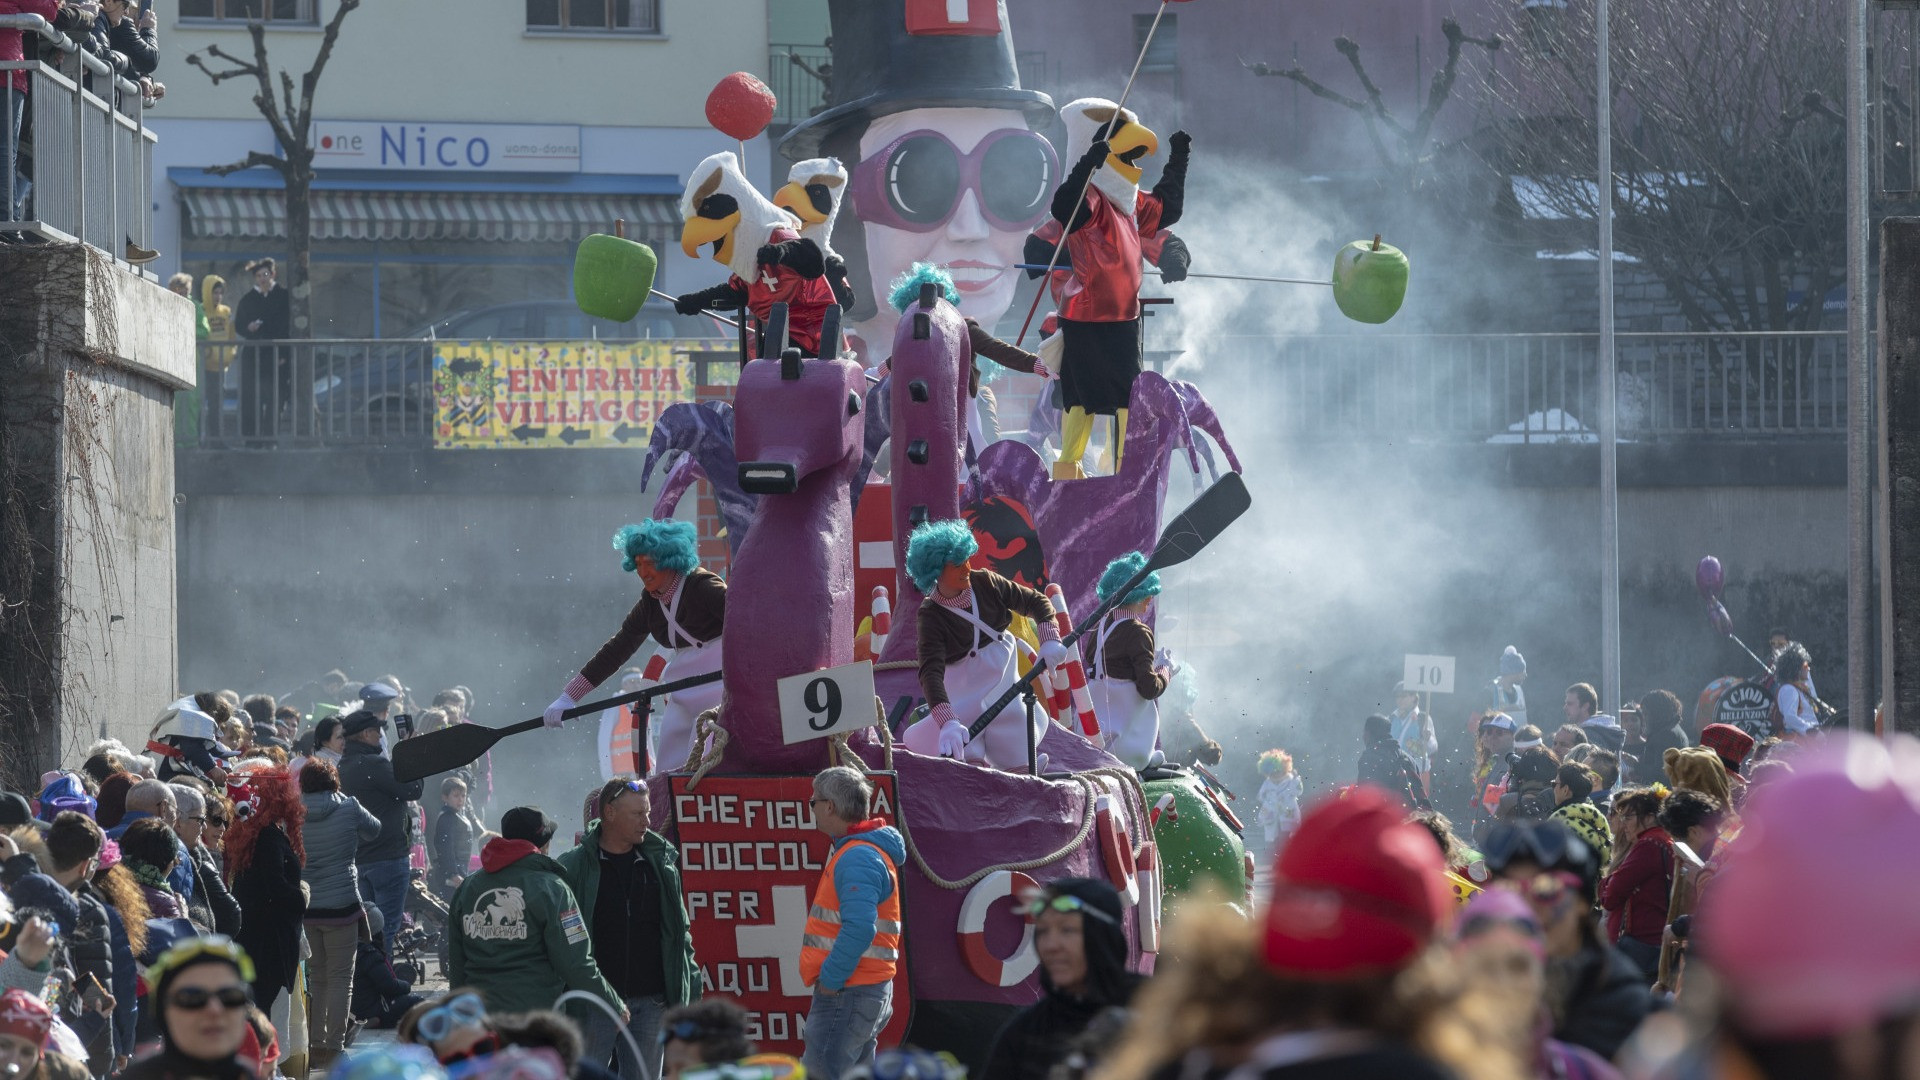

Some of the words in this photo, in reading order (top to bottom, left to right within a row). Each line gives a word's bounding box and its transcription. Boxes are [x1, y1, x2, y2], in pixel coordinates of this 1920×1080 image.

[380, 125, 490, 167] Nico
[508, 368, 681, 392] ENTRATA
[1417, 665, 1442, 686] 10
[803, 677, 842, 731] 9
[675, 794, 740, 823] CHE
[687, 890, 759, 921] PER
